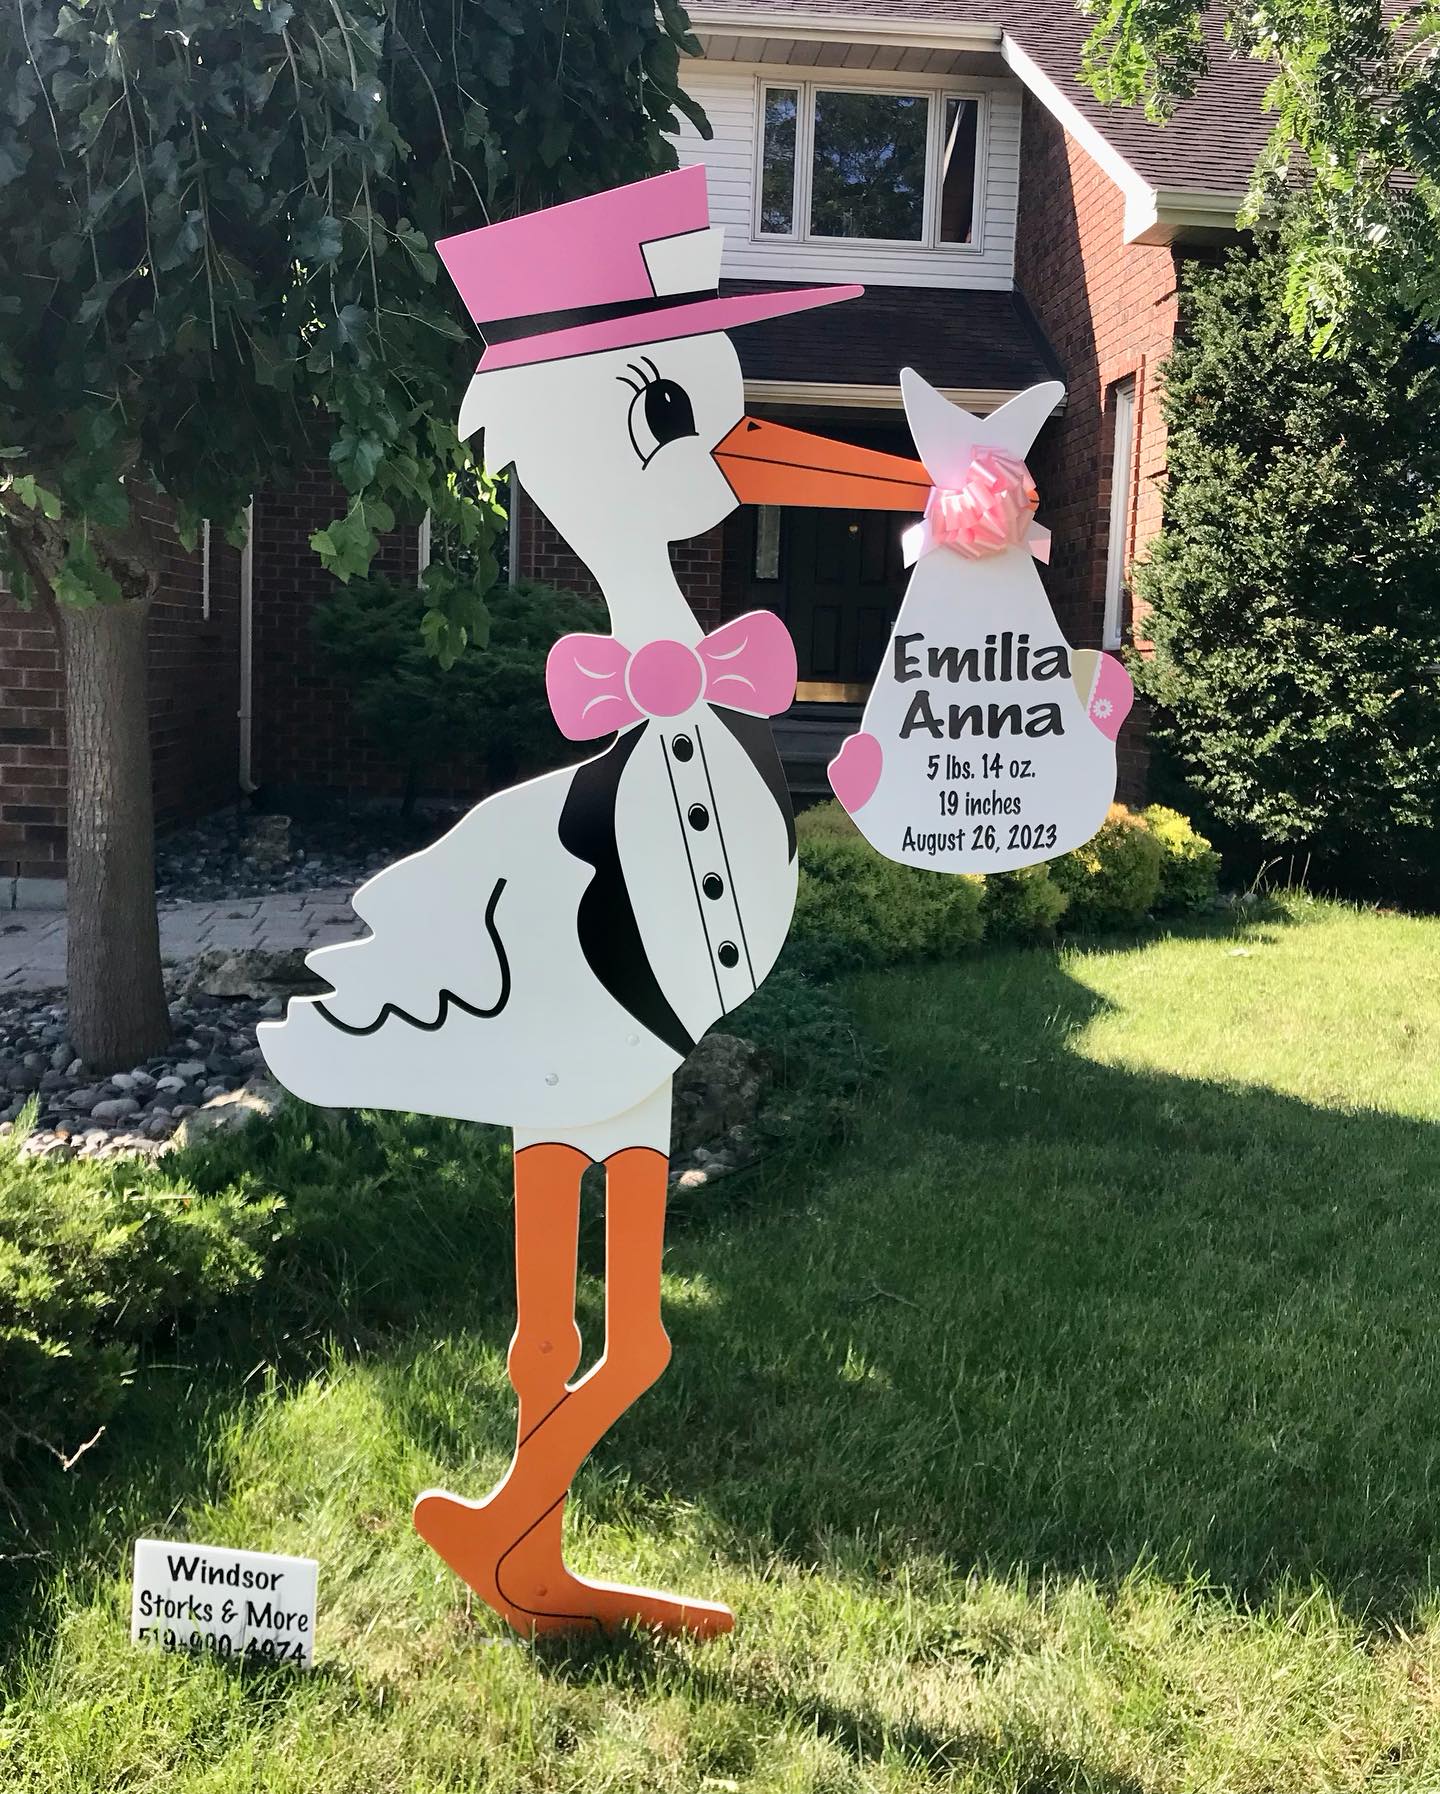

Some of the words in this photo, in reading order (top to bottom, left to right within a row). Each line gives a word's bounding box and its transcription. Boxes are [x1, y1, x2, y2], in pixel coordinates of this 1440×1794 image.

[894, 631, 1071, 683] Emilia
[899, 690, 1065, 739] Anna
[926, 754, 940, 780] 5
[946, 754, 975, 780] lbs.
[982, 752, 1003, 779] 14
[1009, 759, 1036, 779] oz.
[939, 790, 959, 816] 19
[965, 789, 1021, 816] inches
[902, 826, 966, 856] August
[970, 825, 1000, 853] 26,
[1007, 824, 1057, 850] 2023
[167, 1555, 284, 1590] Windsor
[139, 1590, 213, 1622] Storks
[221, 1599, 239, 1623] &
[246, 1600, 309, 1632] More
